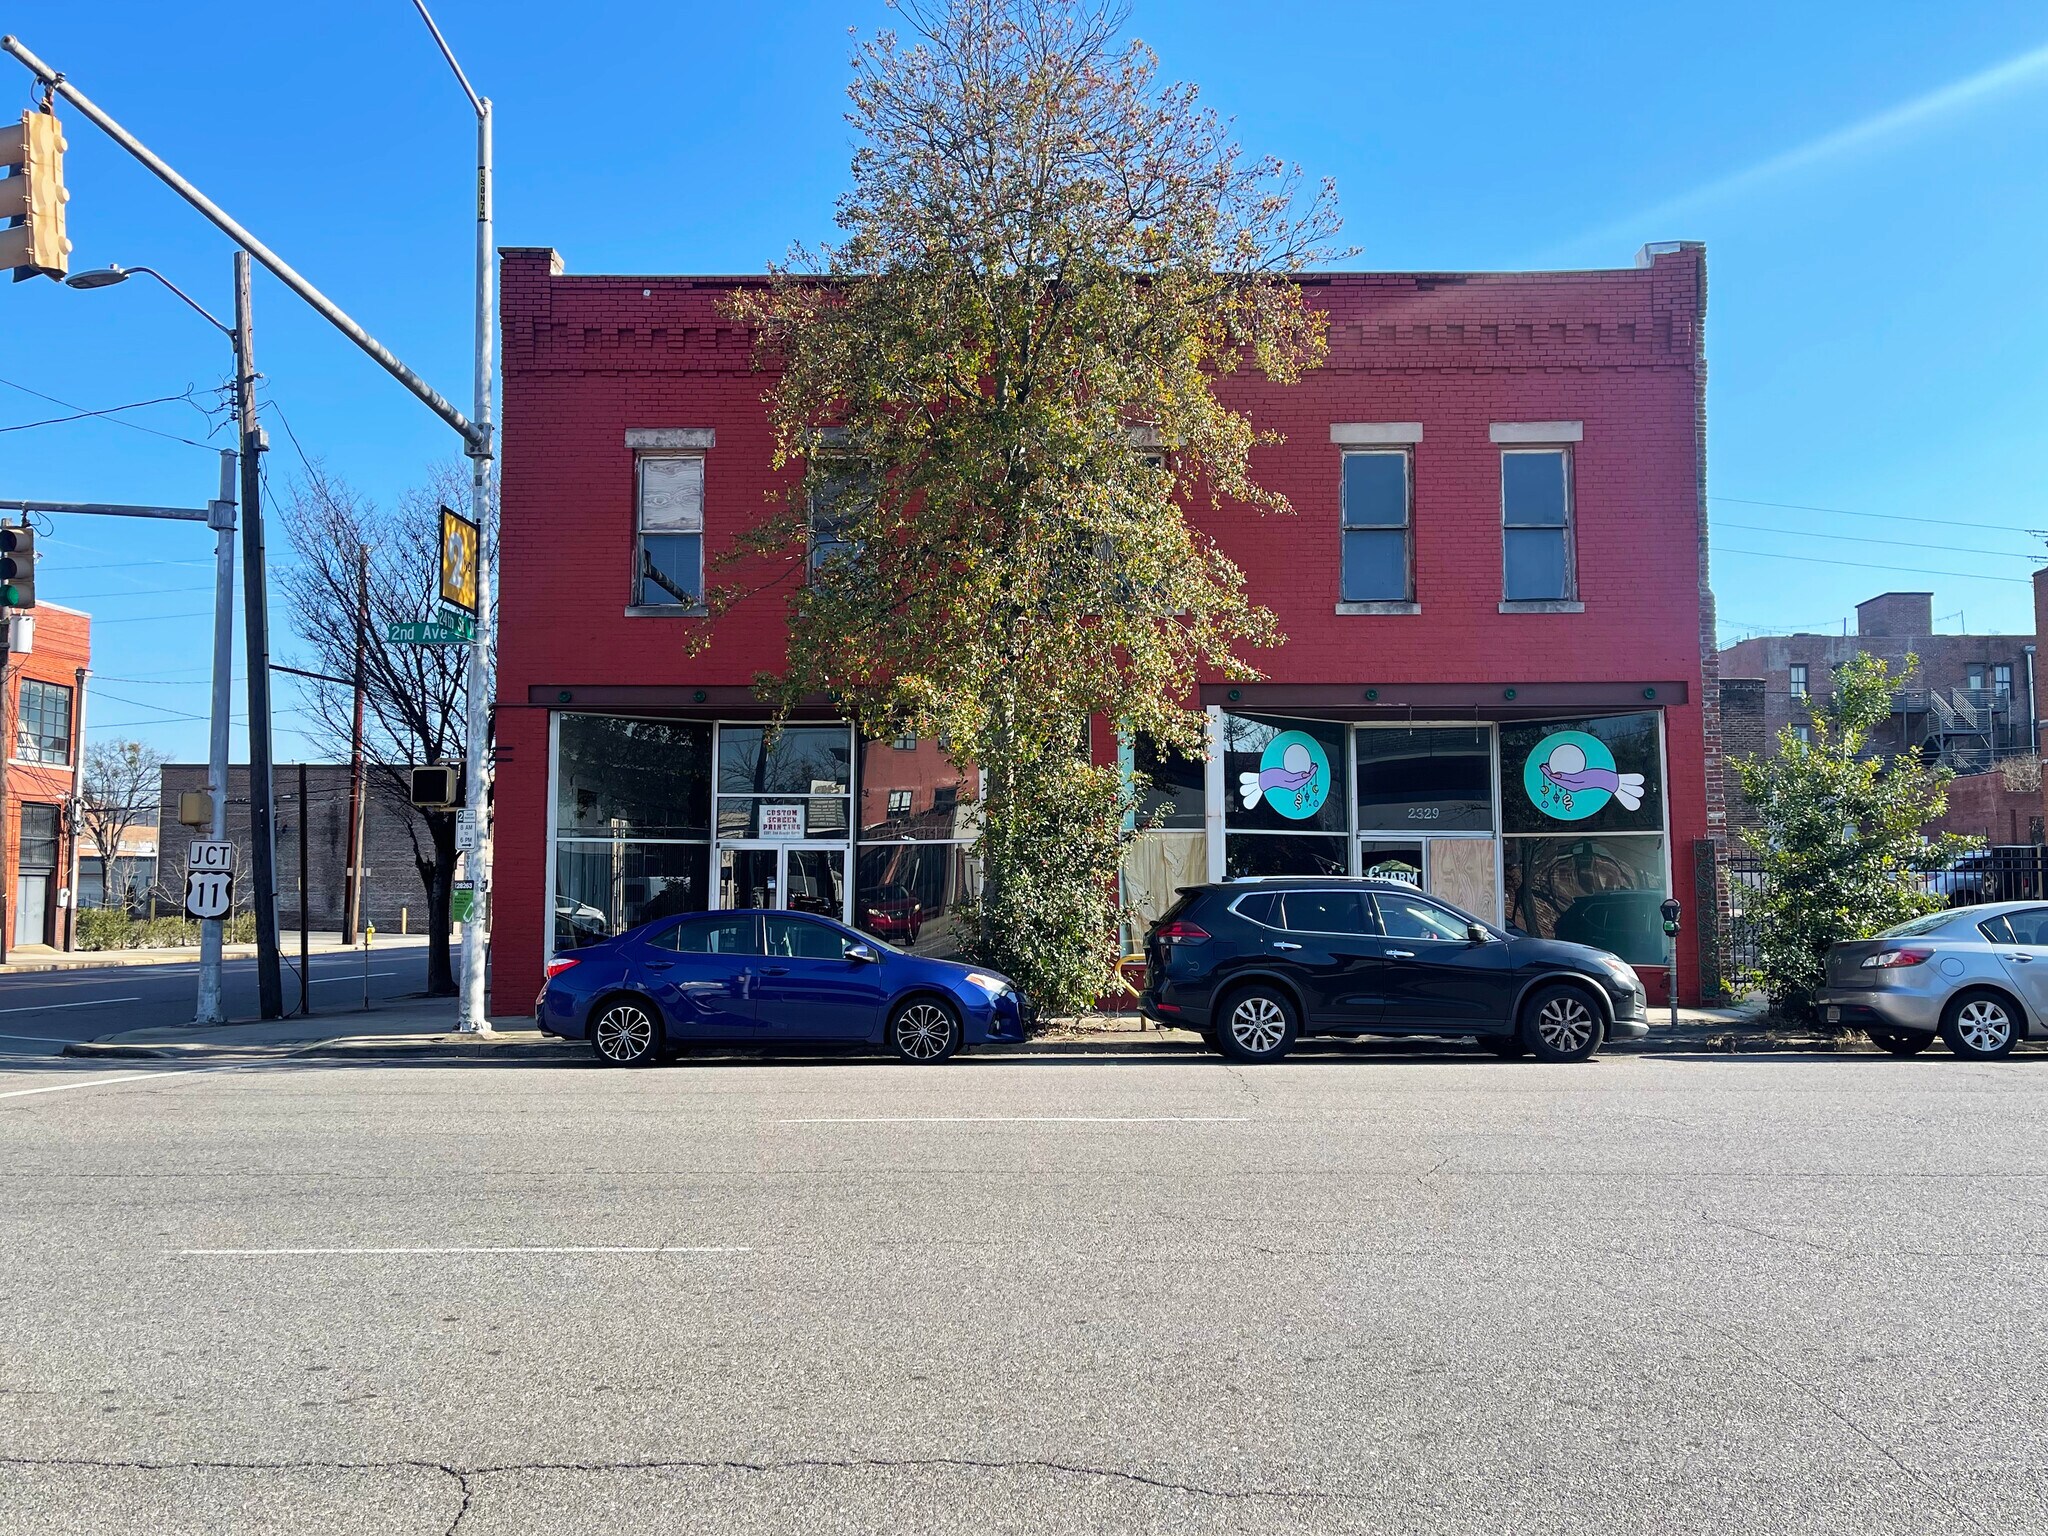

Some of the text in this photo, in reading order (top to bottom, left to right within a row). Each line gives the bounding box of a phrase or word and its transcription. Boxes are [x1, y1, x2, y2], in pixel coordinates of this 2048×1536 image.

[448, 531, 464, 589] 2
[439, 610, 455, 630] 24th
[457, 616, 465, 633] St
[391, 624, 448, 641] 2nd Ave
[458, 811, 464, 821] 2
[1408, 807, 1440, 820] 2329
[191, 846, 230, 865] JCT
[198, 882, 219, 908] 11
